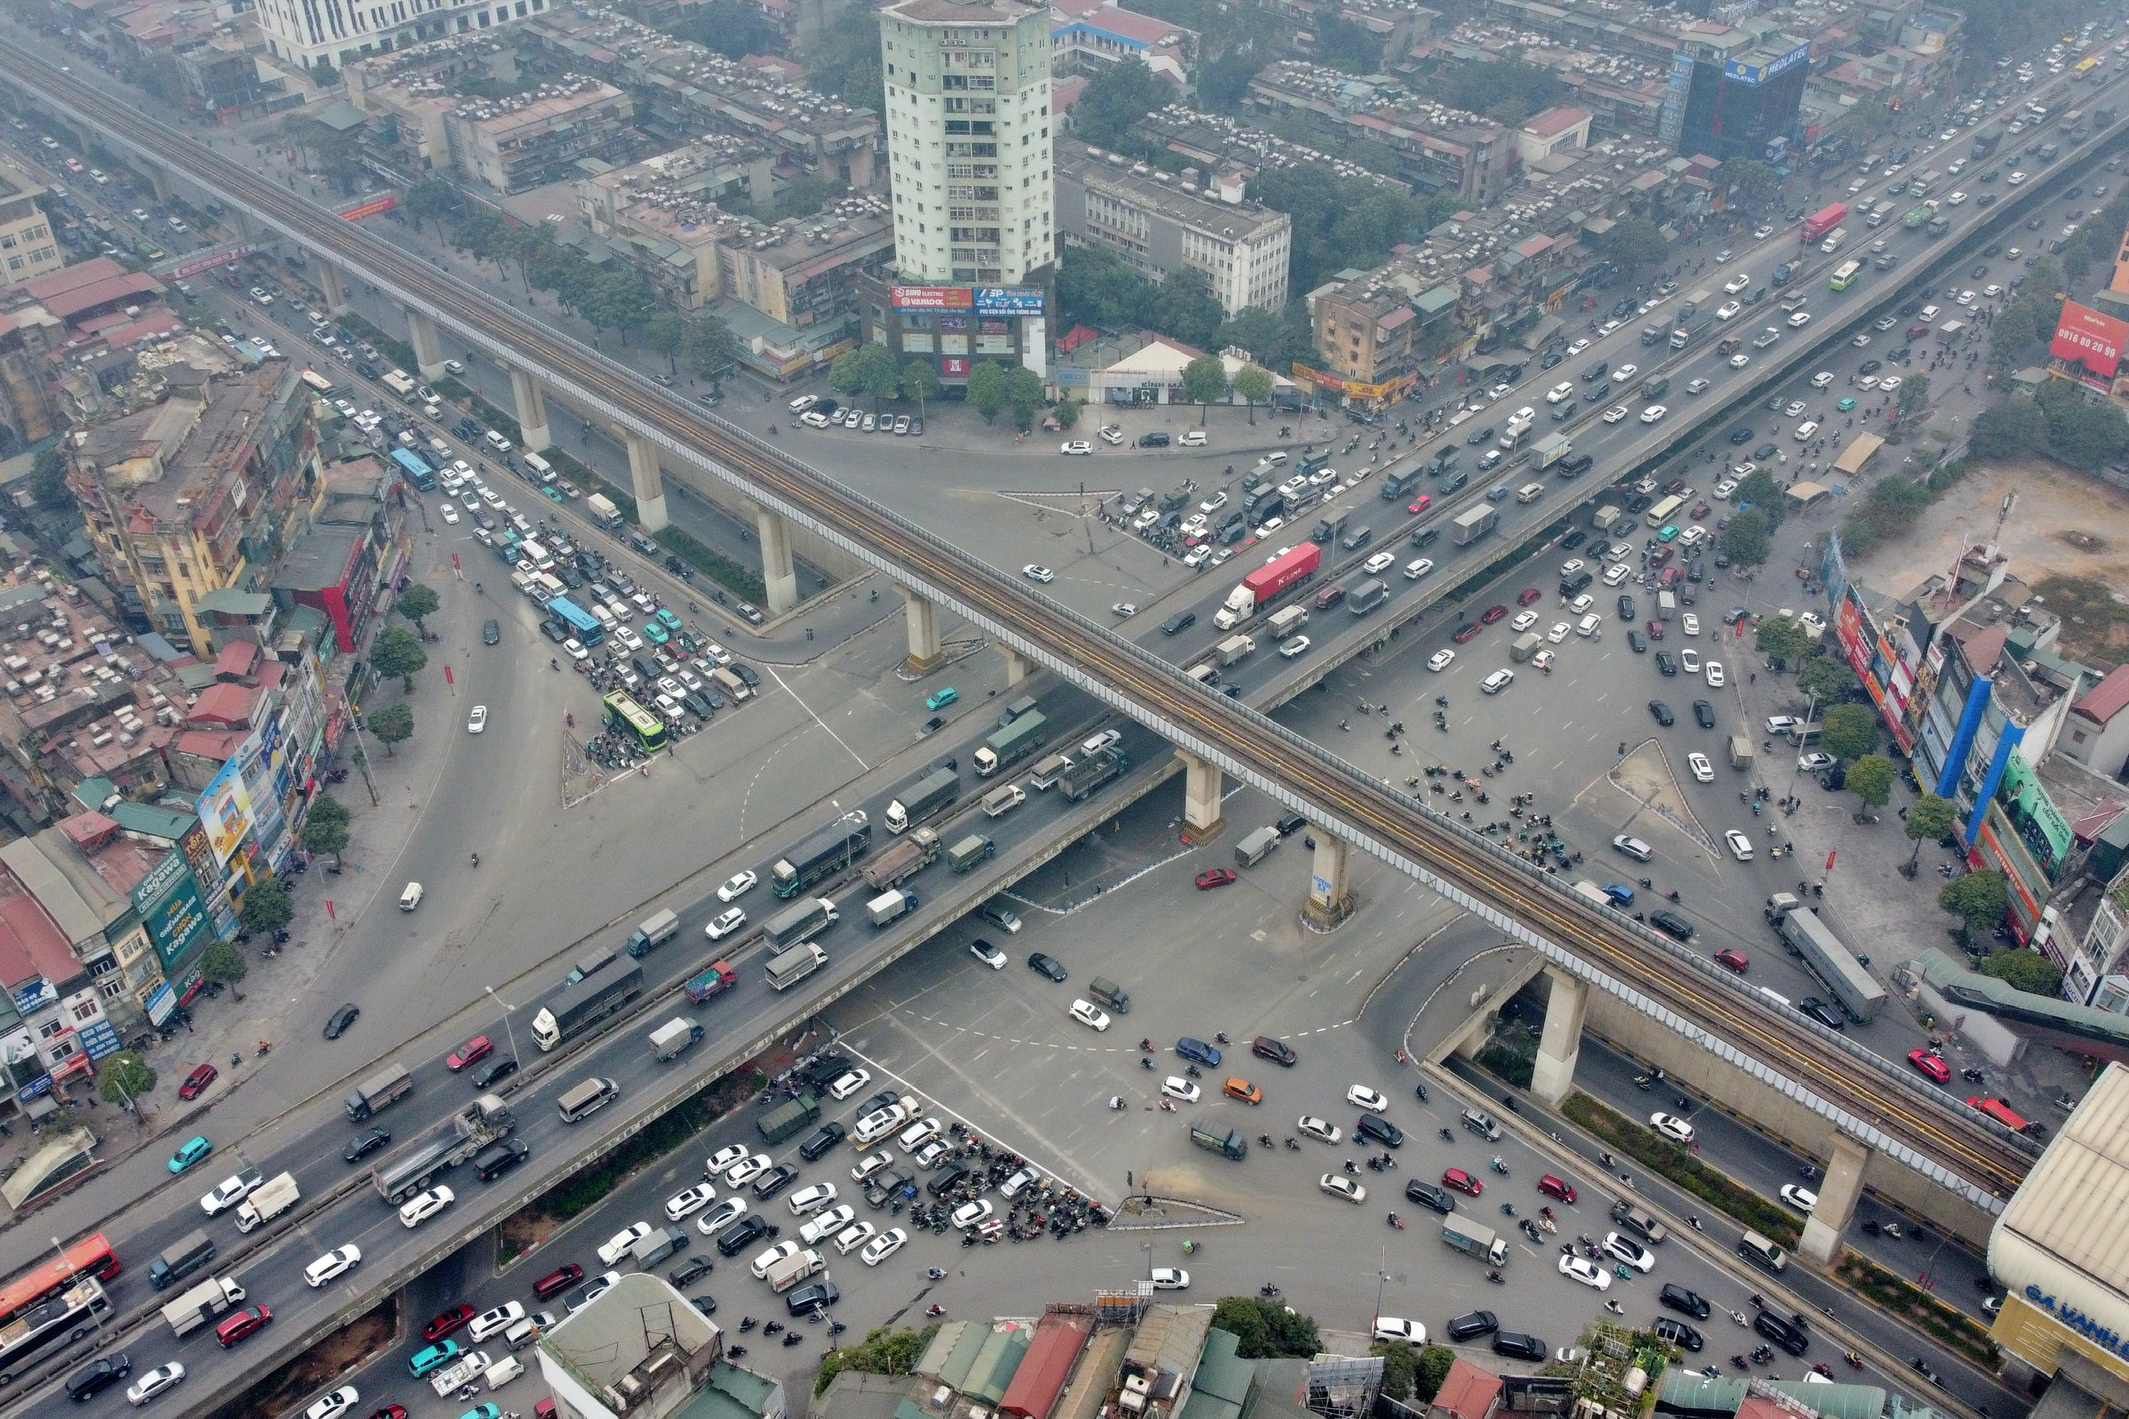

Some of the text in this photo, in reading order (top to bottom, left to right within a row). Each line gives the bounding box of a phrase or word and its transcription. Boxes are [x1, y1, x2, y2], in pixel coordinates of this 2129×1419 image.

[1768, 46, 1808, 75] MEDLATEC
[1725, 72, 1755, 83] MEDLATEC
[2058, 328, 2079, 343] 0916
[2080, 336, 2091, 348] 80
[2092, 341, 2103, 353] 20
[2104, 346, 2116, 358] 99
[137, 858, 180, 901] Kagawa
[166, 912, 203, 956] Kagawa
[2025, 1284, 2057, 1311] GA
